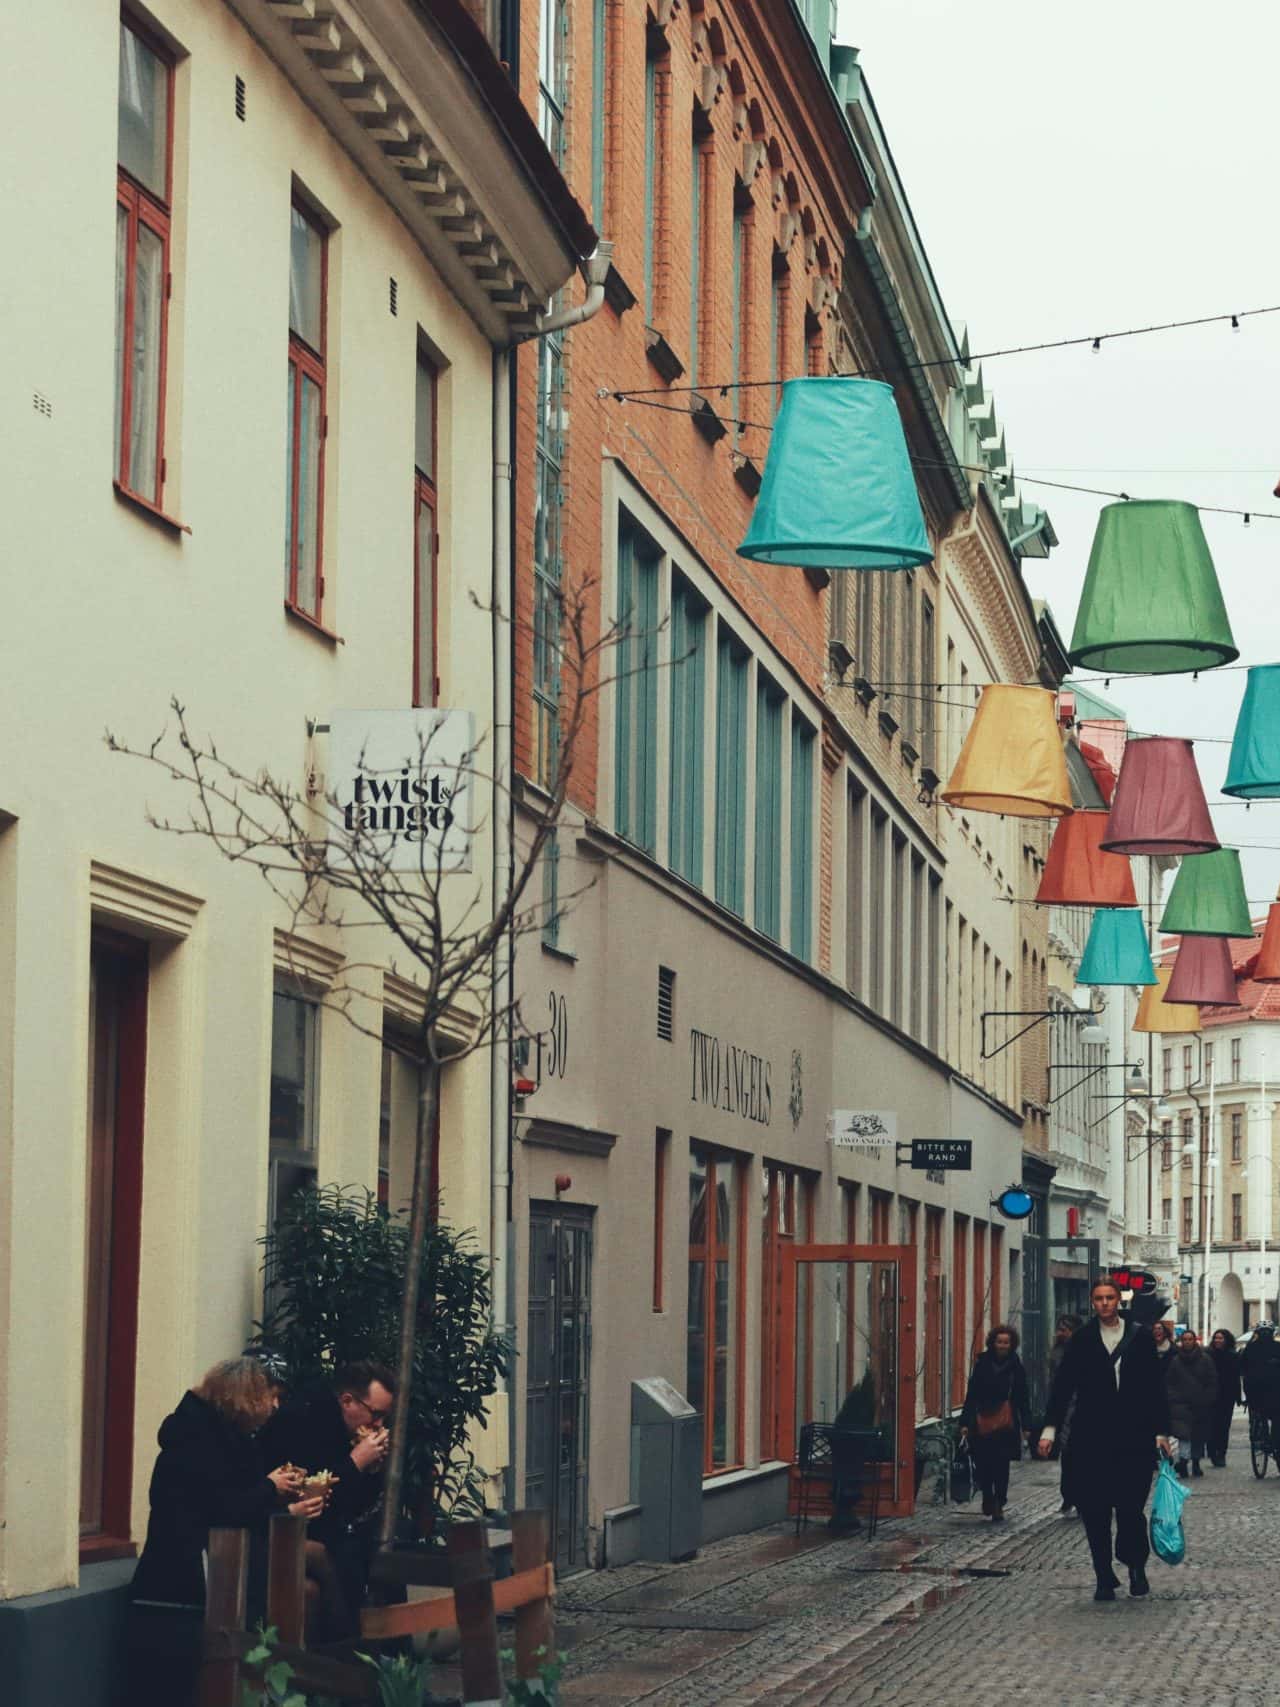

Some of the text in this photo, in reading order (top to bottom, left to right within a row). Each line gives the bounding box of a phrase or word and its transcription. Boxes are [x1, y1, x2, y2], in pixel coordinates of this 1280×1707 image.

[352, 768, 446, 805] twist
[343, 801, 454, 842] tango
[547, 990, 568, 1080] 30
[691, 1028, 772, 1127] TWO ANGELS
[917, 1143, 967, 1152] BITTE KAI
[928, 1153, 956, 1161] RAND
